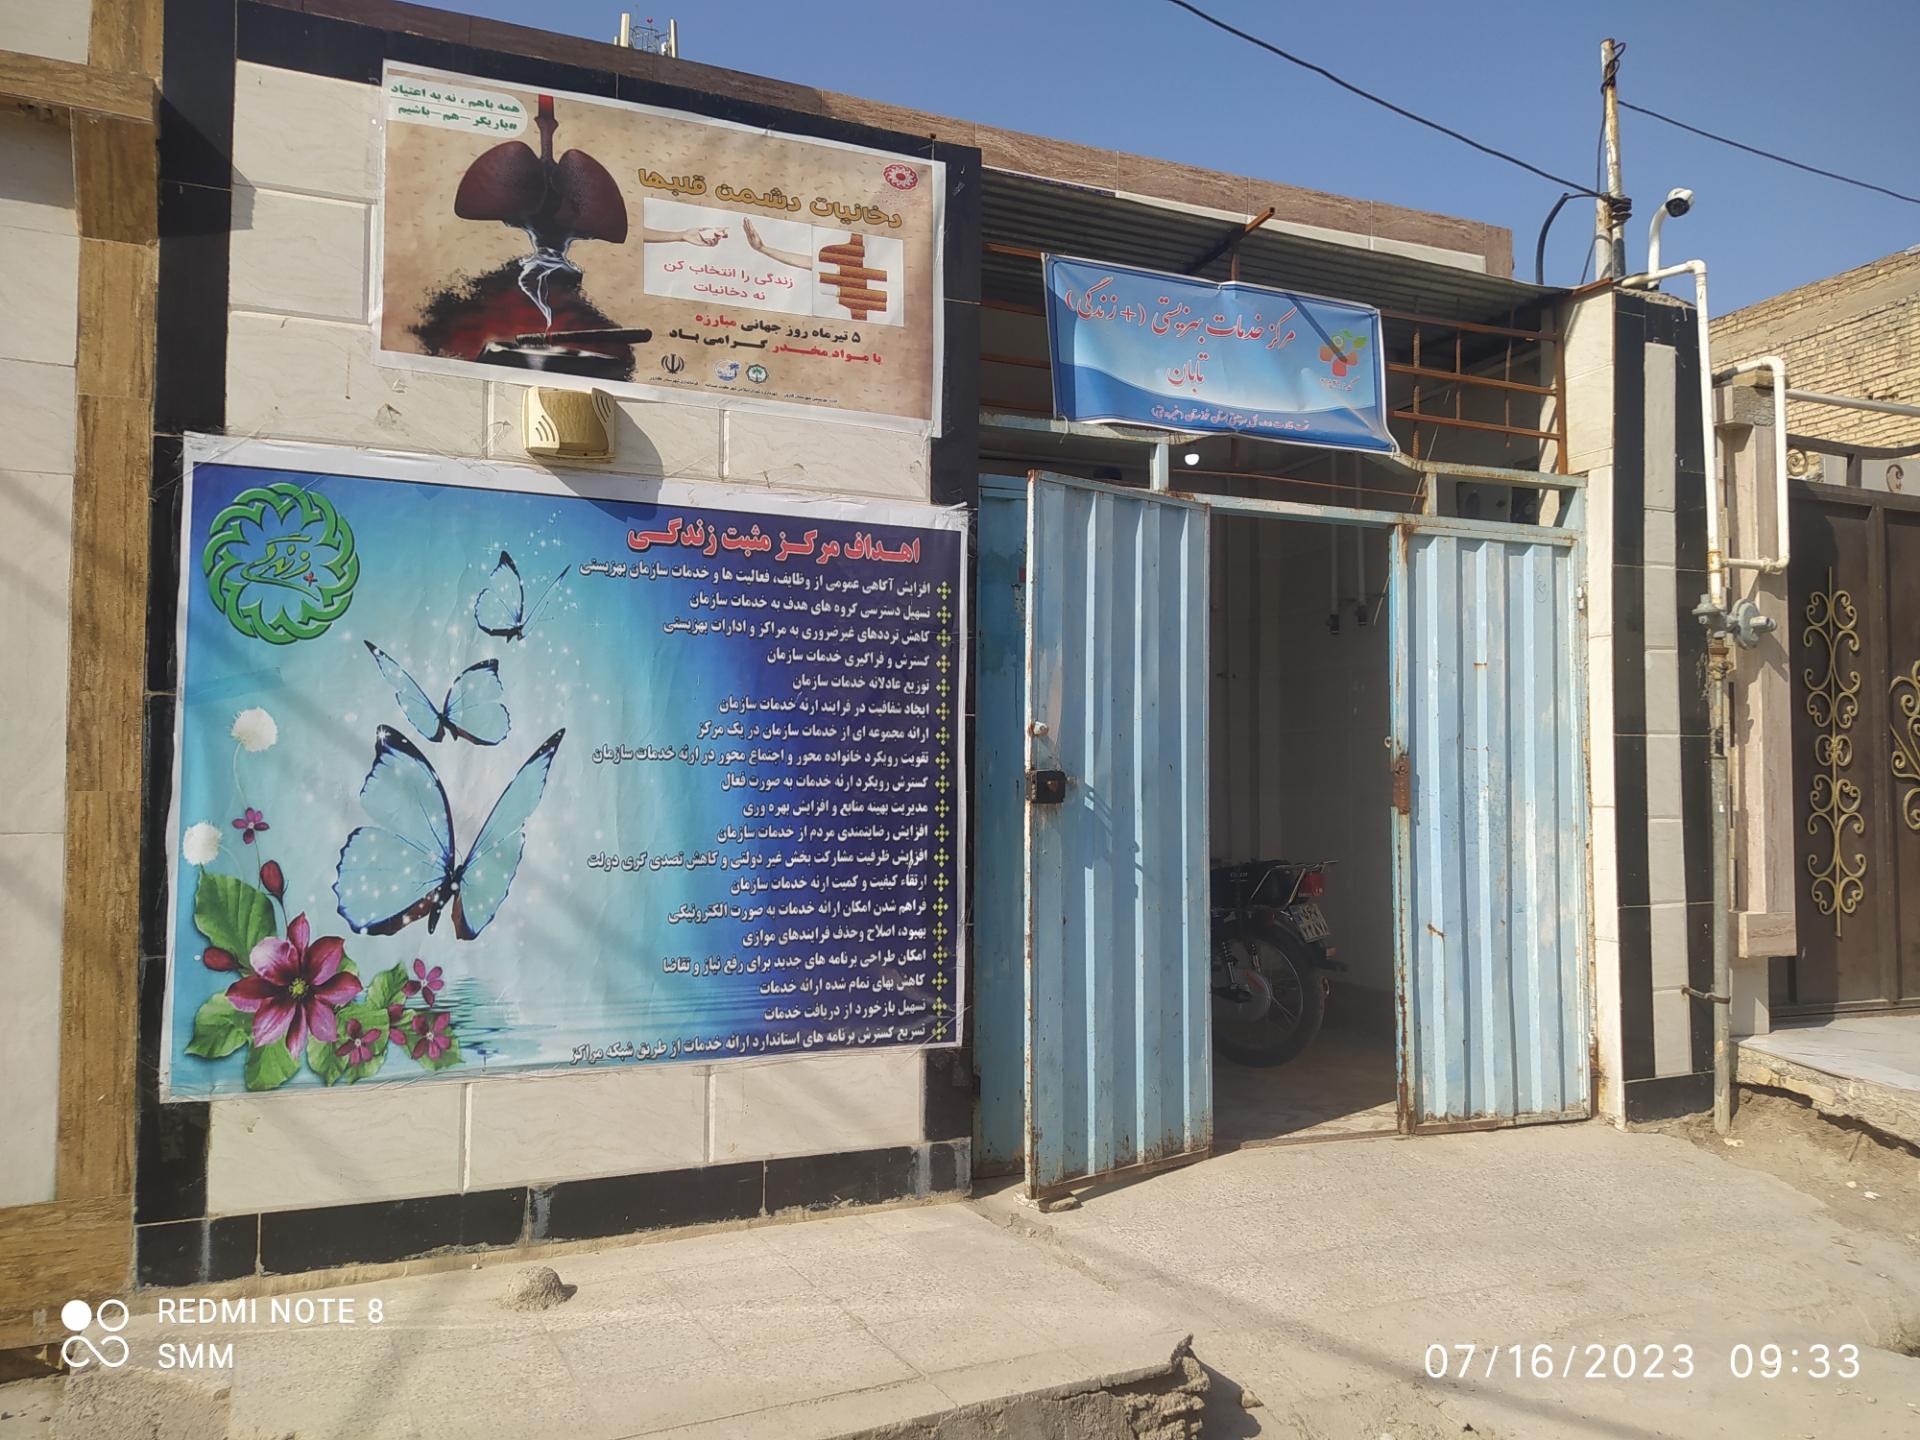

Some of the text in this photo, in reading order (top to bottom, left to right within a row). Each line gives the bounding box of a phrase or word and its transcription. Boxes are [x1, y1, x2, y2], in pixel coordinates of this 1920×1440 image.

[391, 84, 426, 97] اعتیاد
[430, 92, 441, 100] به
[445, 93, 456, 103] نه
[498, 104, 520, 113] همه
[638, 168, 902, 229] دخانیات دشمن قلبها
[663, 260, 794, 289] زندگی را انتخاب کن
[693, 283, 766, 300] نه دخانیات
[695, 313, 737, 327] مبارزه
[741, 319, 781, 335] جهانی
[1151, 296, 1206, 345] بهزیستی
[1206, 313, 1264, 340] خدمات
[1266, 307, 1297, 349] مرکز
[669, 329, 700, 344] باد
[785, 326, 808, 339] روز
[771, 343, 828, 356] مخدر
[832, 349, 869, 363] مواد
[873, 352, 883, 364] با
[1168, 352, 1210, 393] تابان
[627, 519, 920, 563] اهداف مرکز مثبت زندگی
[580, 562, 627, 578] بهزیستی
[629, 562, 667, 579] سازمان
[671, 565, 709, 578] خدمات
[735, 569, 770, 585] فعالیت
[825, 580, 859, 592] عمومی
[896, 582, 930, 597] افزایش
[689, 592, 930, 620] تسهیل دسترسی های هدف خدمات سازمان
[663, 618, 708, 635] بهزیستی
[710, 619, 746, 635] ادارات
[759, 621, 786, 638] مراکز
[901, 630, 930, 645] کاهش
[767, 647, 841, 664] خدمات سازمان
[792, 674, 828, 689] سازمان
[830, 675, 865, 688] خدمات
[903, 679, 929, 695] توزیع
[718, 697, 757, 713] سازمان
[759, 698, 796, 710] خدمات
[853, 703, 865, 717] در
[868, 701, 901, 716] شفافیت
[904, 703, 929, 718] ایجاد
[697, 721, 723, 739] مرکز
[726, 723, 743, 737] یک
[746, 726, 759, 739] در
[762, 723, 799, 740] سازمان
[801, 724, 837, 737] خدمات
[868, 729, 904, 742] مجموعه
[592, 746, 929, 767] تقویت رویکرد خانواده محور اجتماع محور در خدمات سازمان
[721, 774, 889, 792] رویکرد خدمات صورت فعال
[792, 800, 829, 816] افزایش
[839, 800, 864, 816] منابع
[866, 803, 888, 815] بهینه
[890, 803, 928, 816] مدیریت
[717, 826, 755, 843] سازمان
[757, 825, 794, 838] خدمات
[809, 828, 834, 841] مردم
[892, 824, 927, 841] افزایش
[586, 848, 927, 870] افزایش ظرفیت مشارکت بخش غیر دولتی کاهش تصدی دولت
[730, 877, 768, 894] سازمان
[770, 876, 807, 889] خدمات
[831, 875, 858, 891] کمیت
[869, 874, 898, 890] کیفیت
[729, 907, 763, 920] صورت
[777, 902, 815, 915] خدمات
[842, 900, 871, 917] امکان
[872, 900, 896, 916] شدن
[898, 898, 927, 915] فراهم
[741, 929, 775, 946] موازی
[866, 924, 895, 941] اصلاح
[745, 956, 771, 973] برای
[774, 957, 801, 970] جدید
[804, 952, 825, 970] های
[827, 952, 857, 968] برنامه
[859, 949, 895, 968] طراحی
[897, 949, 926, 966] امکان
[702, 957, 721, 975] نیاز
[722, 959, 743, 975] رفع
[759, 973, 925, 993] کاهش بهای تمام شده خدمات
[763, 998, 926, 1020] تسهیل دریافت خدمات
[751, 1032, 800, 1051] استاندارد
[802, 1031, 823, 1048] های
[826, 1029, 855, 1045] برنامه
[606, 1042, 633, 1059] شبکه
[635, 1041, 667, 1059] طریق
[682, 1039, 722, 1053] خدمات
